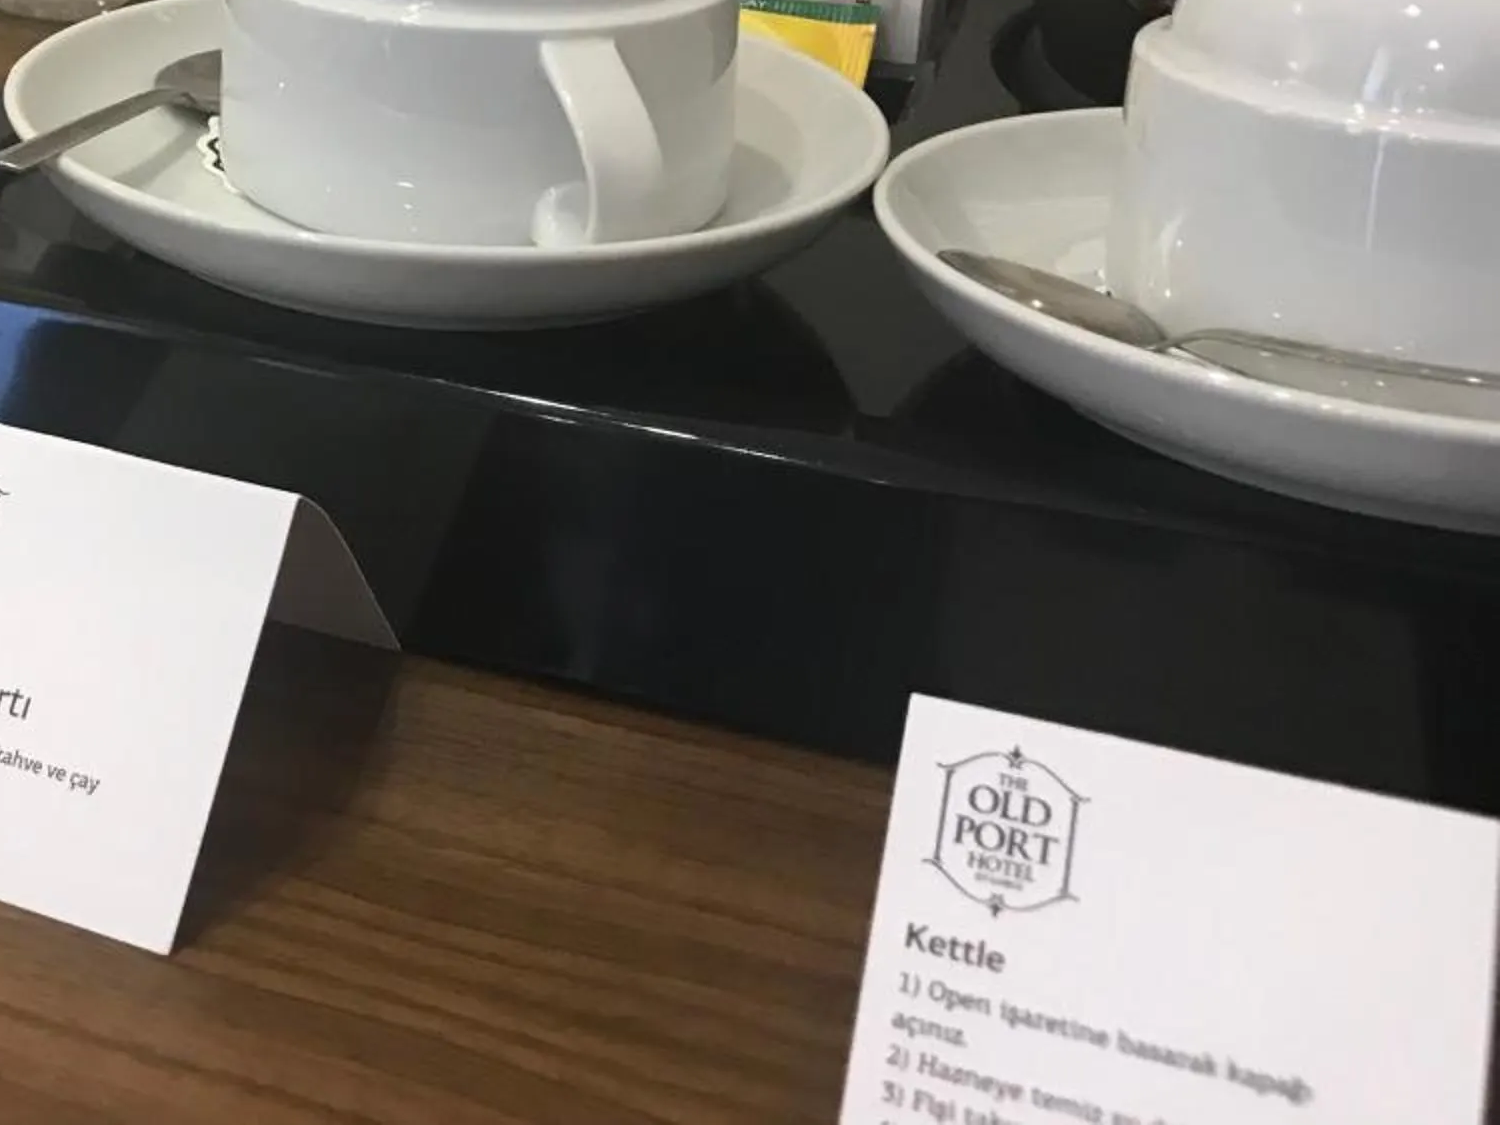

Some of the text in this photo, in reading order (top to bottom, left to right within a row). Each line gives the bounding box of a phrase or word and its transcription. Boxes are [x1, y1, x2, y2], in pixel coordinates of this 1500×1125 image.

[46, 762, 67, 782] ve
[69, 772, 100, 796] çay
[999, 771, 1029, 792] THE
[967, 783, 1052, 826] OLD
[954, 813, 1060, 865] PORT
[966, 850, 1035, 883] HOTEL
[904, 921, 1007, 974] Kettle
[898, 971, 921, 998] 1)
[927, 979, 992, 1015] Open
[885, 1043, 910, 1071] 2)
